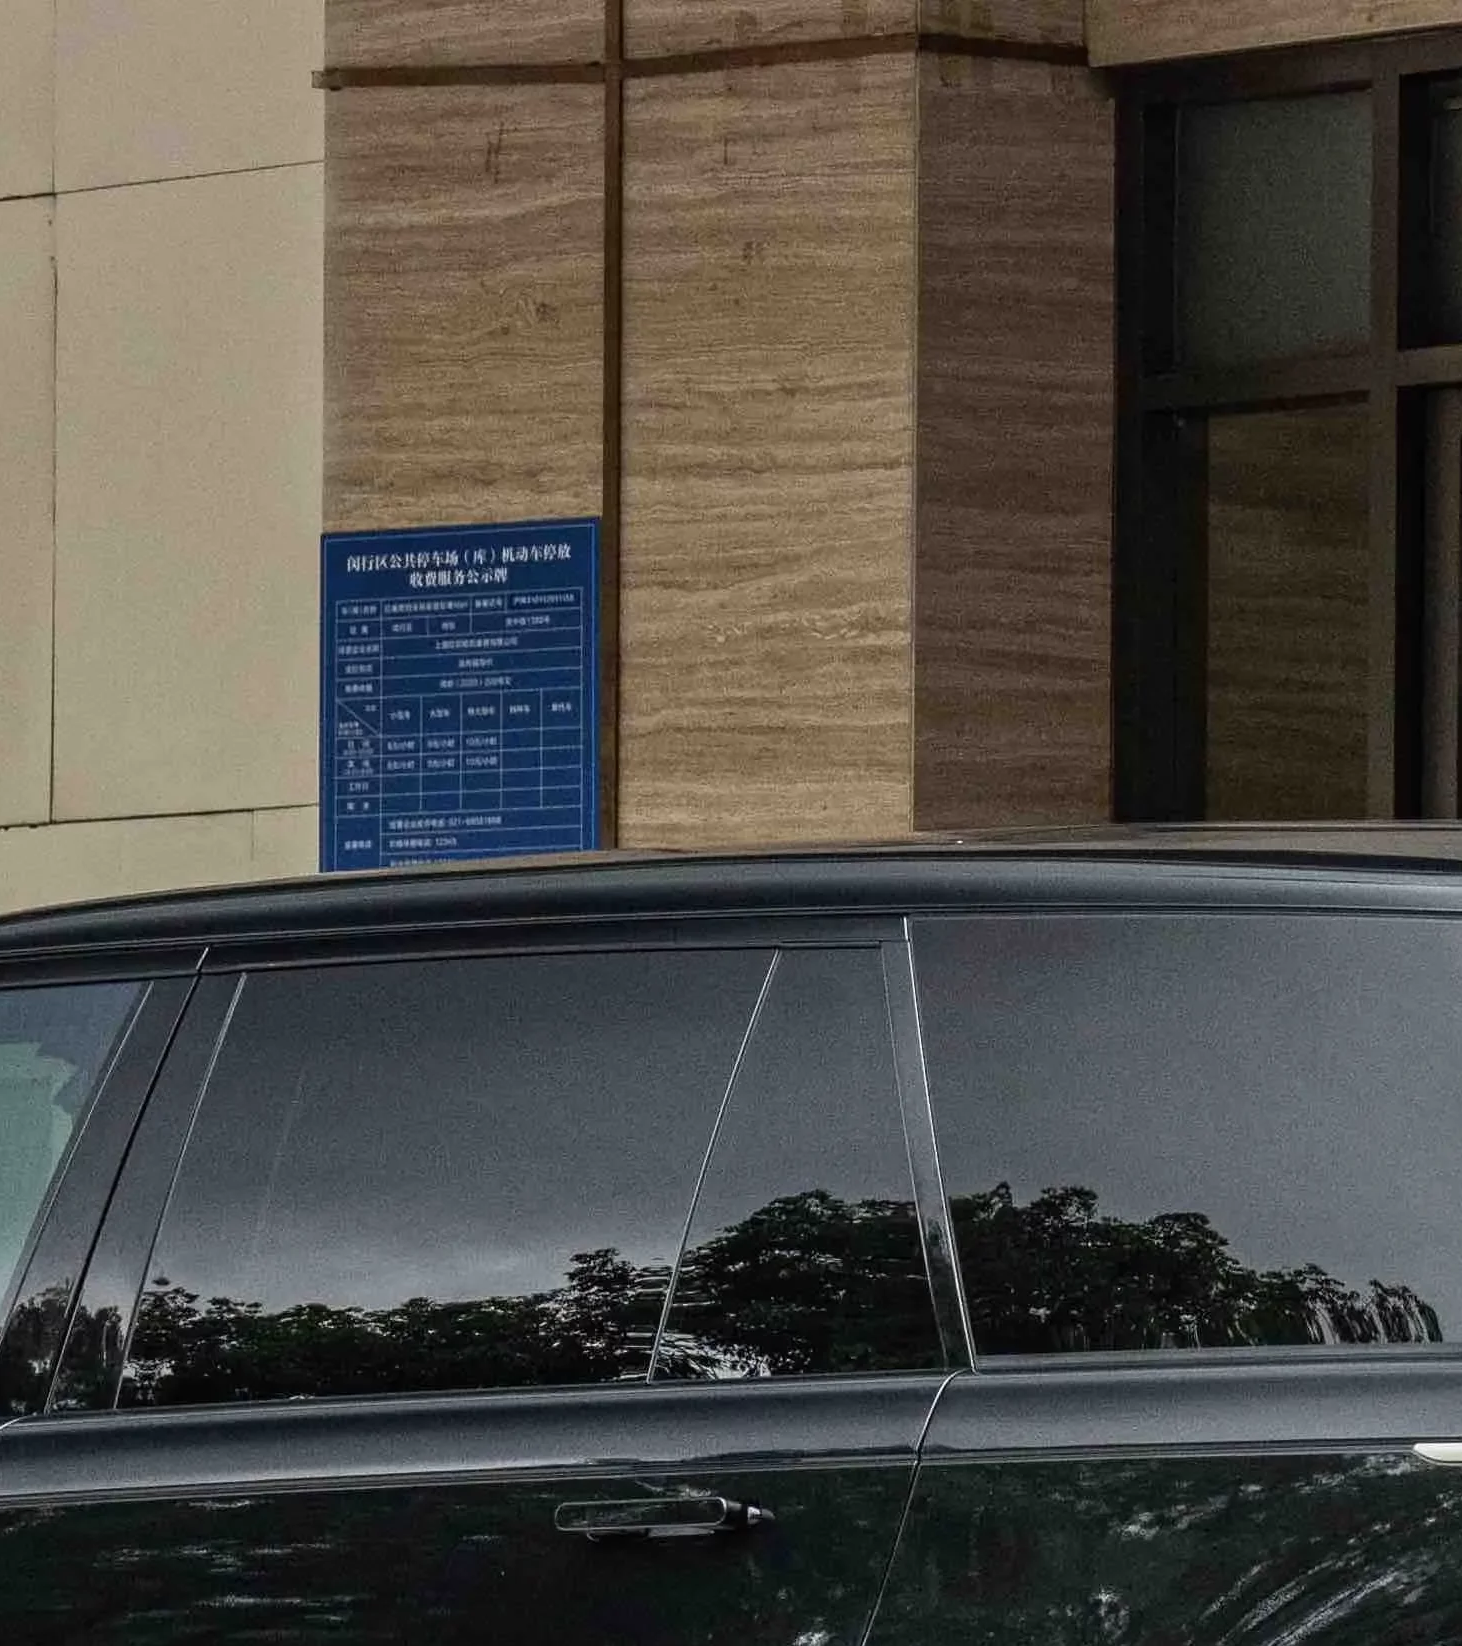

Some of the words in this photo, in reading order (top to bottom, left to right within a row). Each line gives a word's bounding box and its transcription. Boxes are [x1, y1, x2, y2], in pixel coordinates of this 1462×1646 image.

[409, 567, 508, 588] 收费服务公示牌
